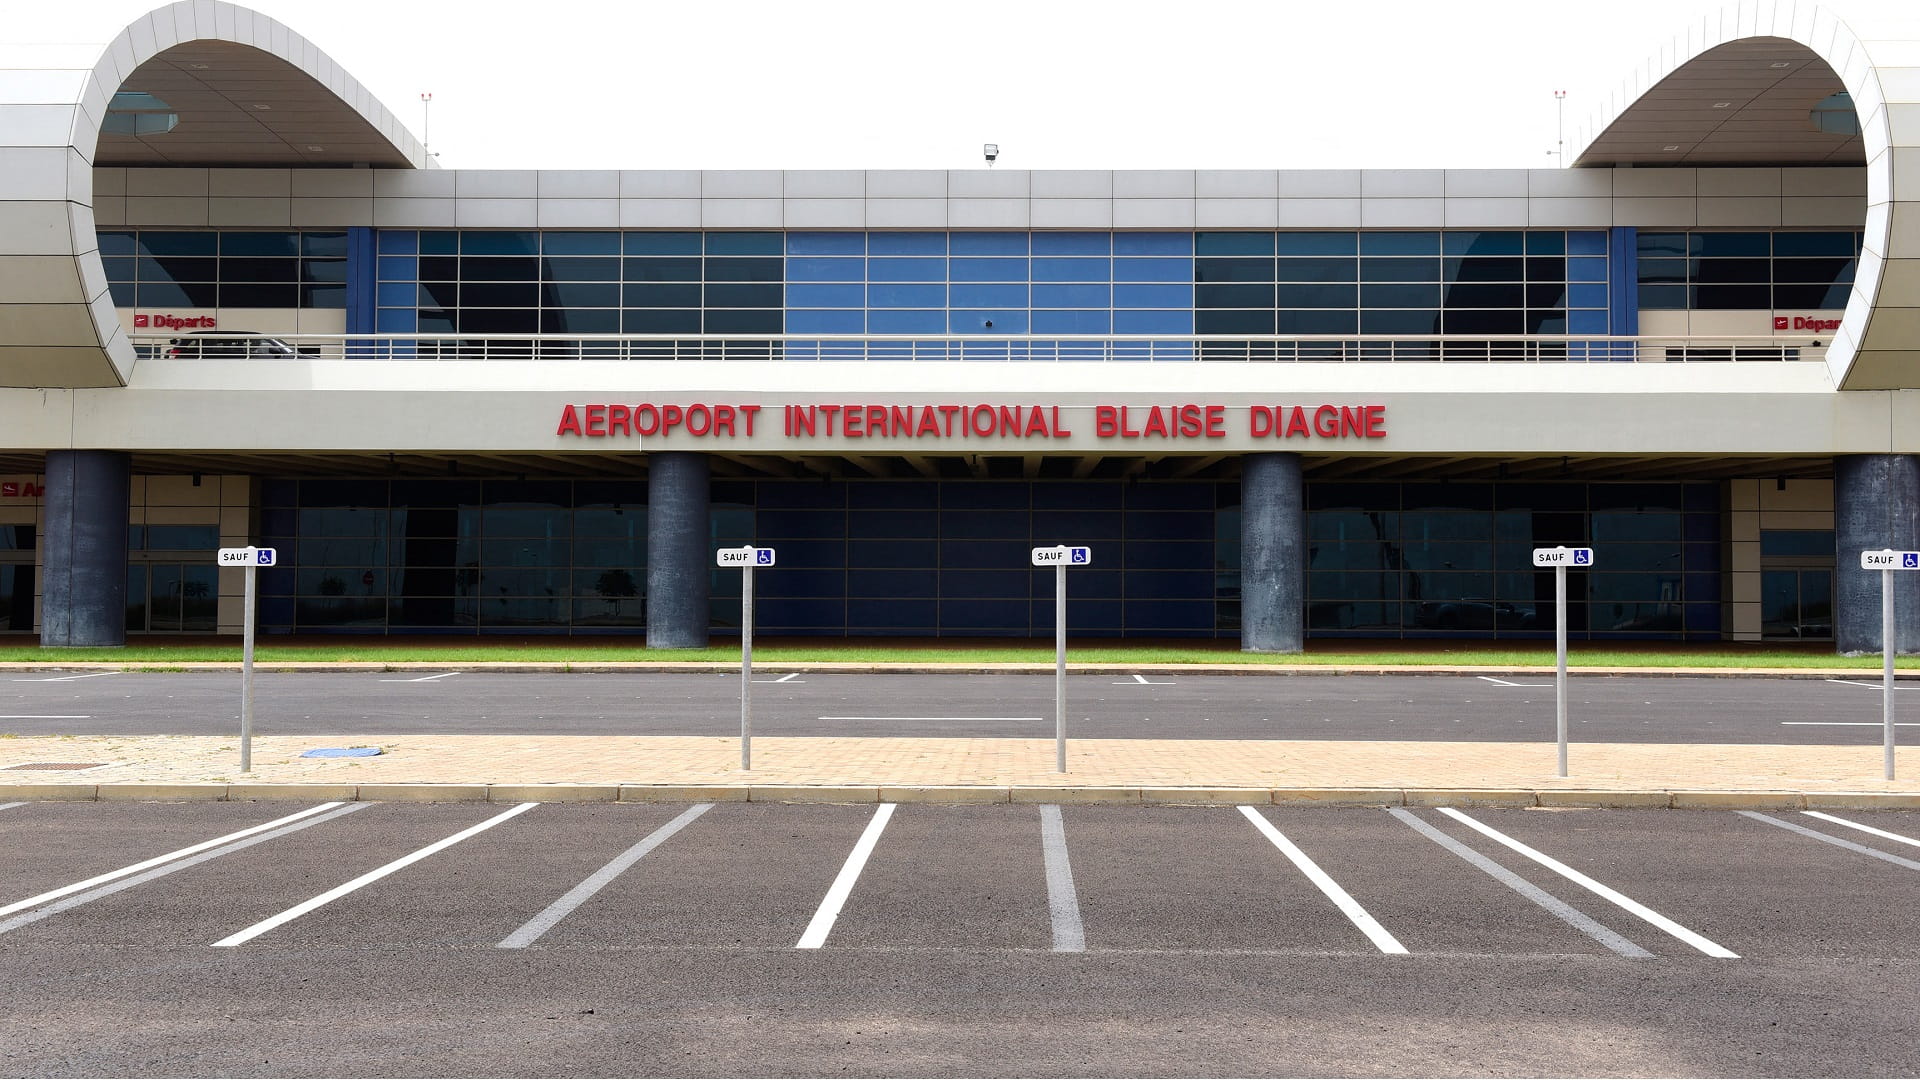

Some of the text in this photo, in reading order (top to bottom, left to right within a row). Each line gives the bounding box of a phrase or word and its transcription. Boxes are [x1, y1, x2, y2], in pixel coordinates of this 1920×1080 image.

[153, 314, 215, 331] Départs
[556, 403, 1387, 438] AEROPORT INTERNATIONAL BLAISE DIAGNE
[222, 551, 250, 562] SAUF
[722, 552, 750, 562] SAUF
[1036, 550, 1064, 562] SAUF
[1537, 552, 1566, 563] SAUF
[1866, 554, 1895, 565] SAUF
